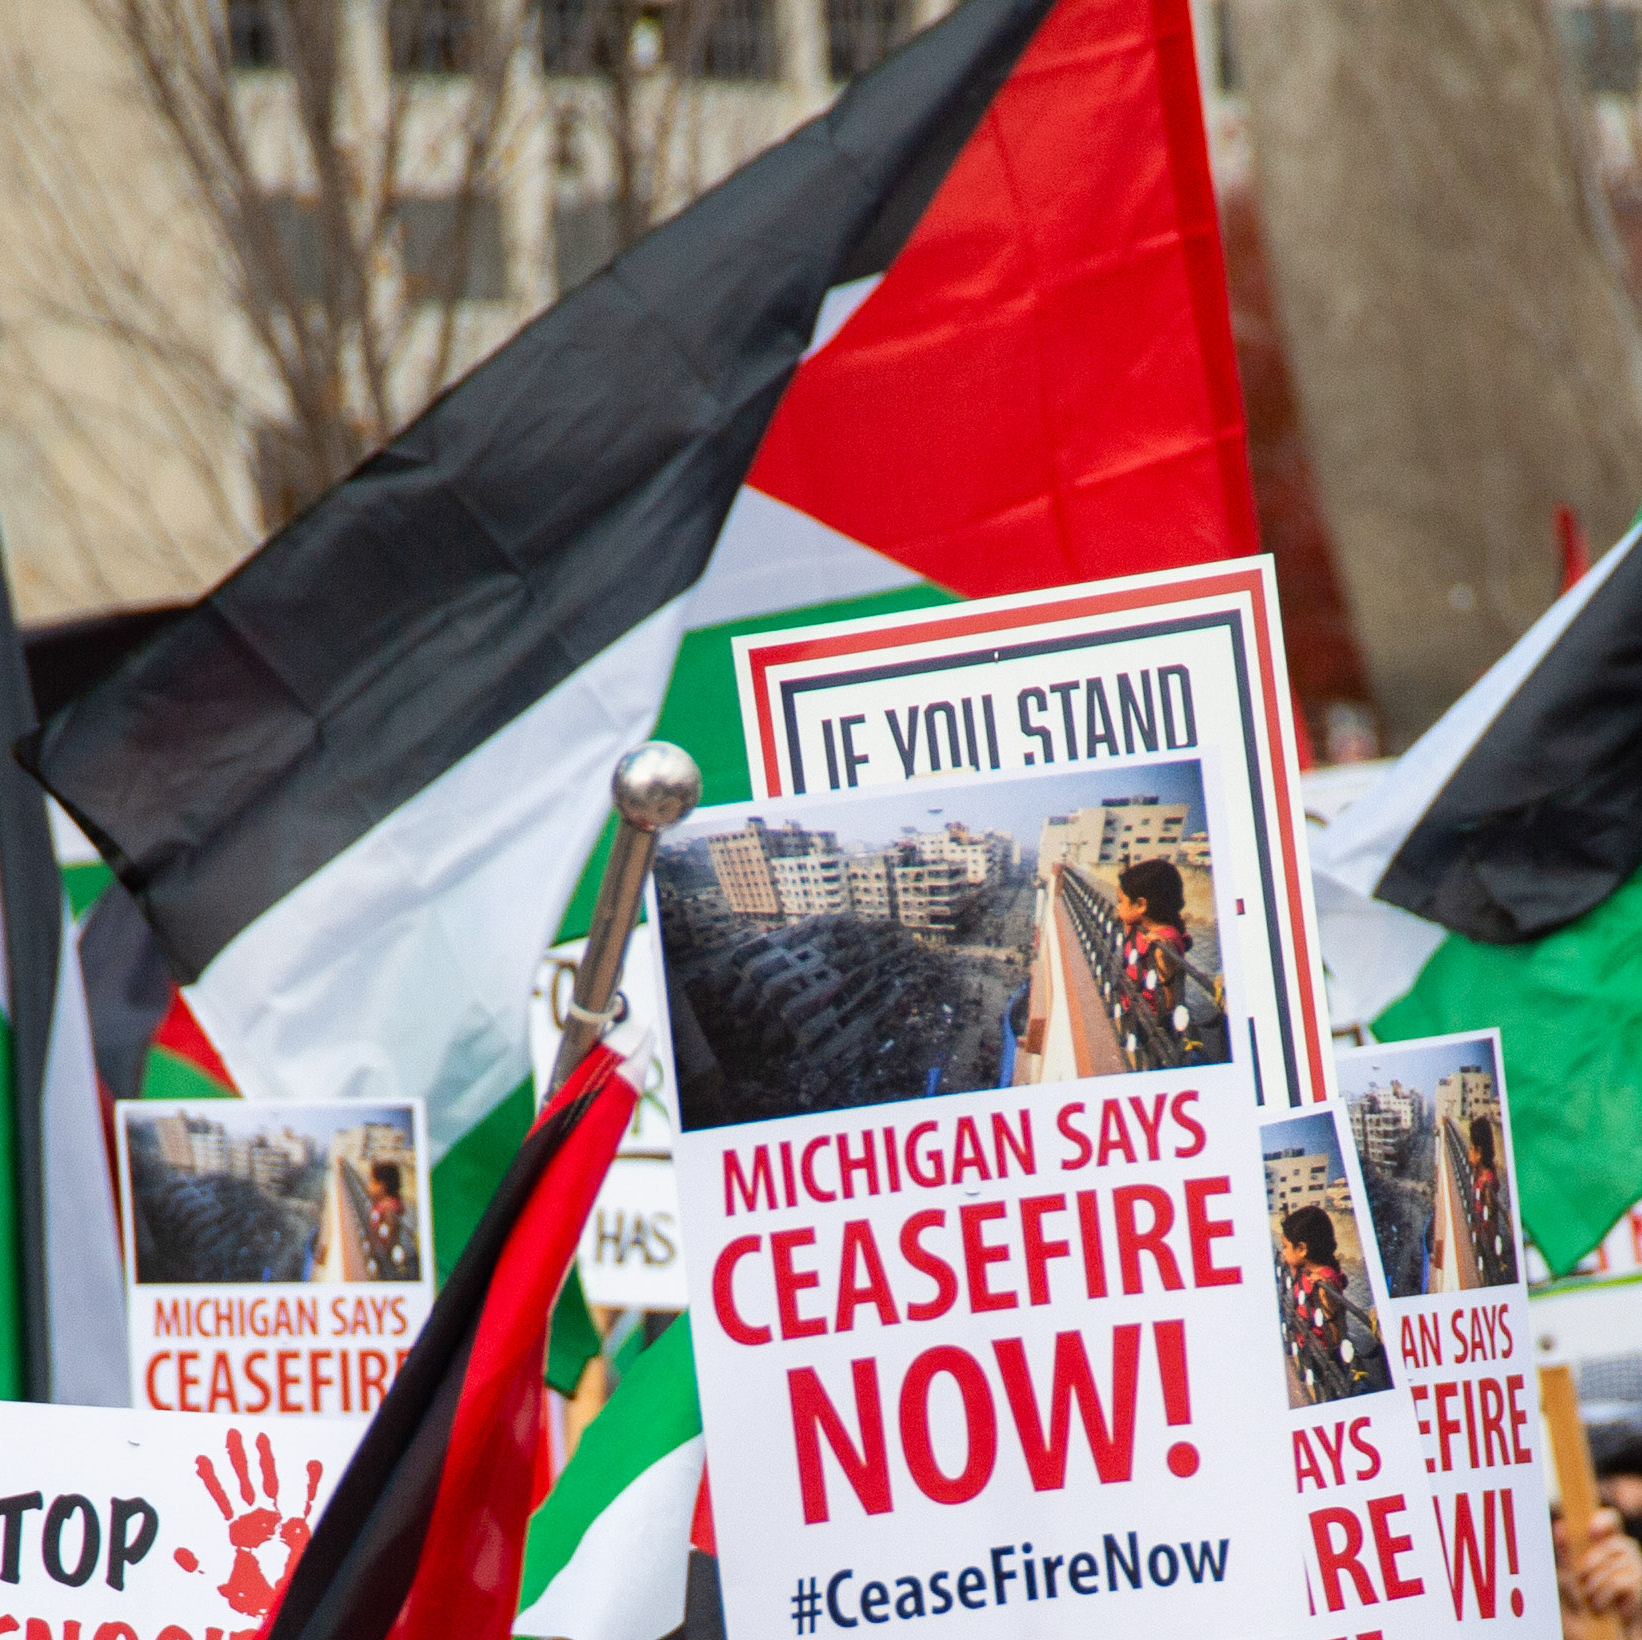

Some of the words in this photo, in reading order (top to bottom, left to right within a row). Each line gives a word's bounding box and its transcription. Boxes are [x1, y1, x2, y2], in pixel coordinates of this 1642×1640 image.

[822, 714, 870, 790] IF
[1018, 663, 1199, 763] STAND
[722, 1107, 1037, 1217] MICHIGAN
[1060, 1089, 1208, 1171] SAYS
[595, 1208, 677, 1267] HAS
[712, 1175, 1244, 1346] CEASEFIRE
[154, 1298, 319, 1338] MICHIGAN
[331, 1296, 407, 1336] SAYS
[1451, 1303, 1514, 1363] SAYS
[787, 1317, 1201, 1526] NOW!
[790, 1530, 1231, 1636] #CeaseFireNow
[1303, 1493, 1426, 1617] RE
